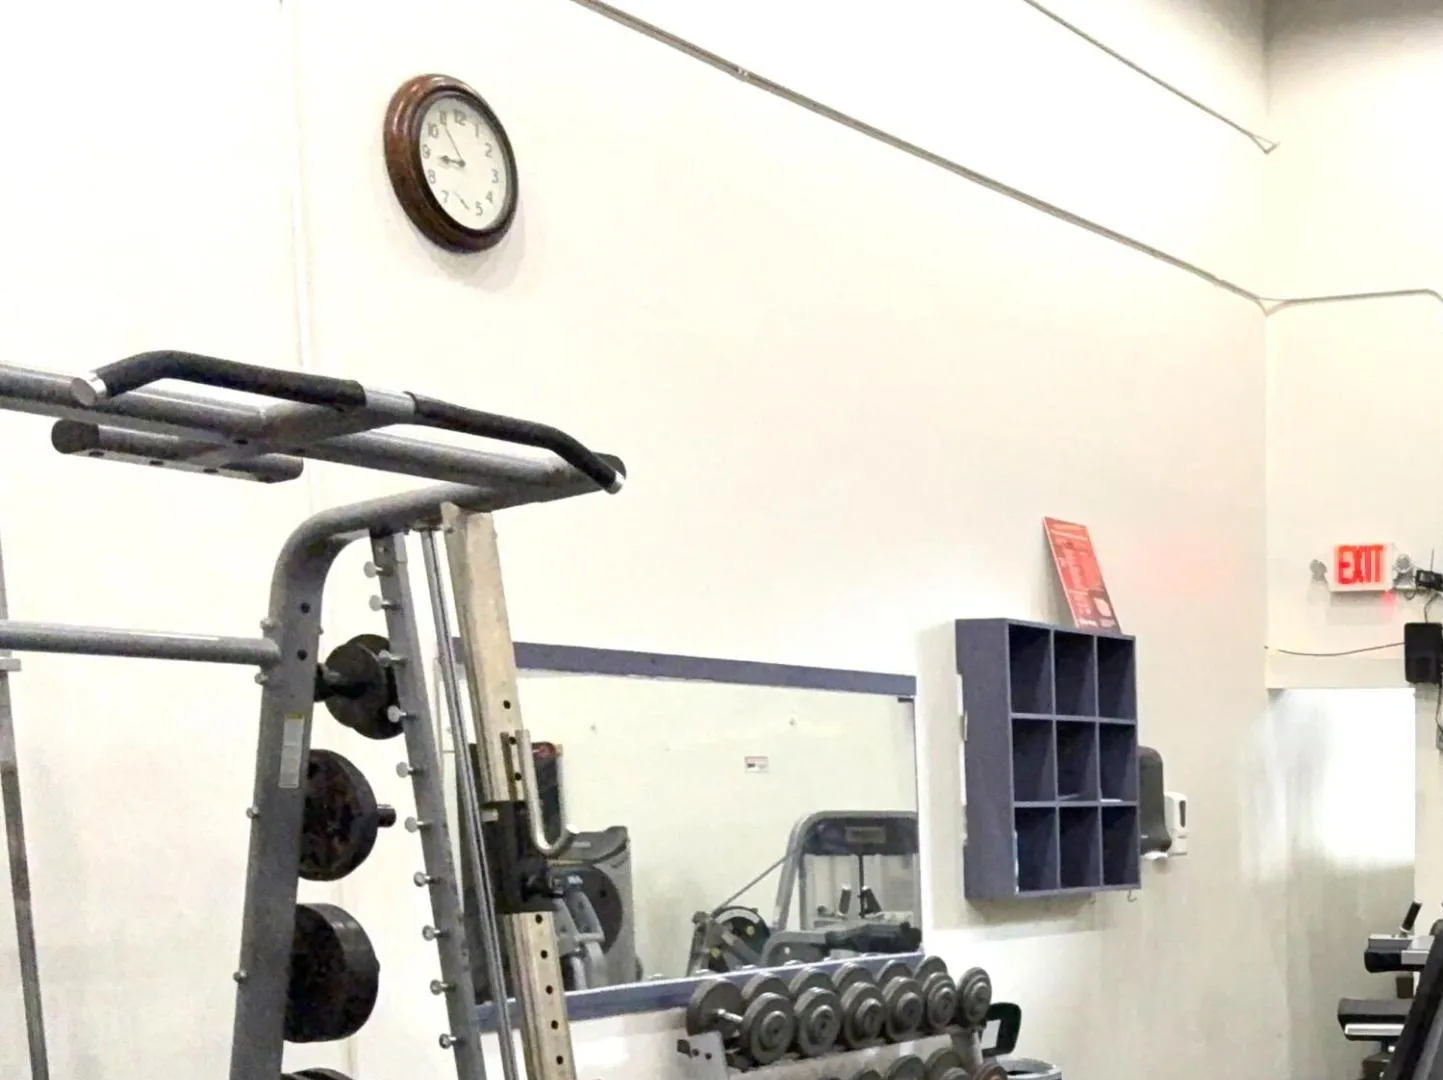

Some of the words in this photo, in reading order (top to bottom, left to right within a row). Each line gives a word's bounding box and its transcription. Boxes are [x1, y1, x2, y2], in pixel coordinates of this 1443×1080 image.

[454, 108, 466, 126] 12
[428, 120, 439, 139] 10
[422, 144, 431, 159] 9
[484, 142, 493, 159] 2
[428, 169, 436, 184] 8
[491, 168, 499, 184] 3
[441, 190, 449, 204] 7
[485, 190, 494, 205] 4
[475, 200, 483, 217] 5
[1338, 544, 1384, 584] EXIT
